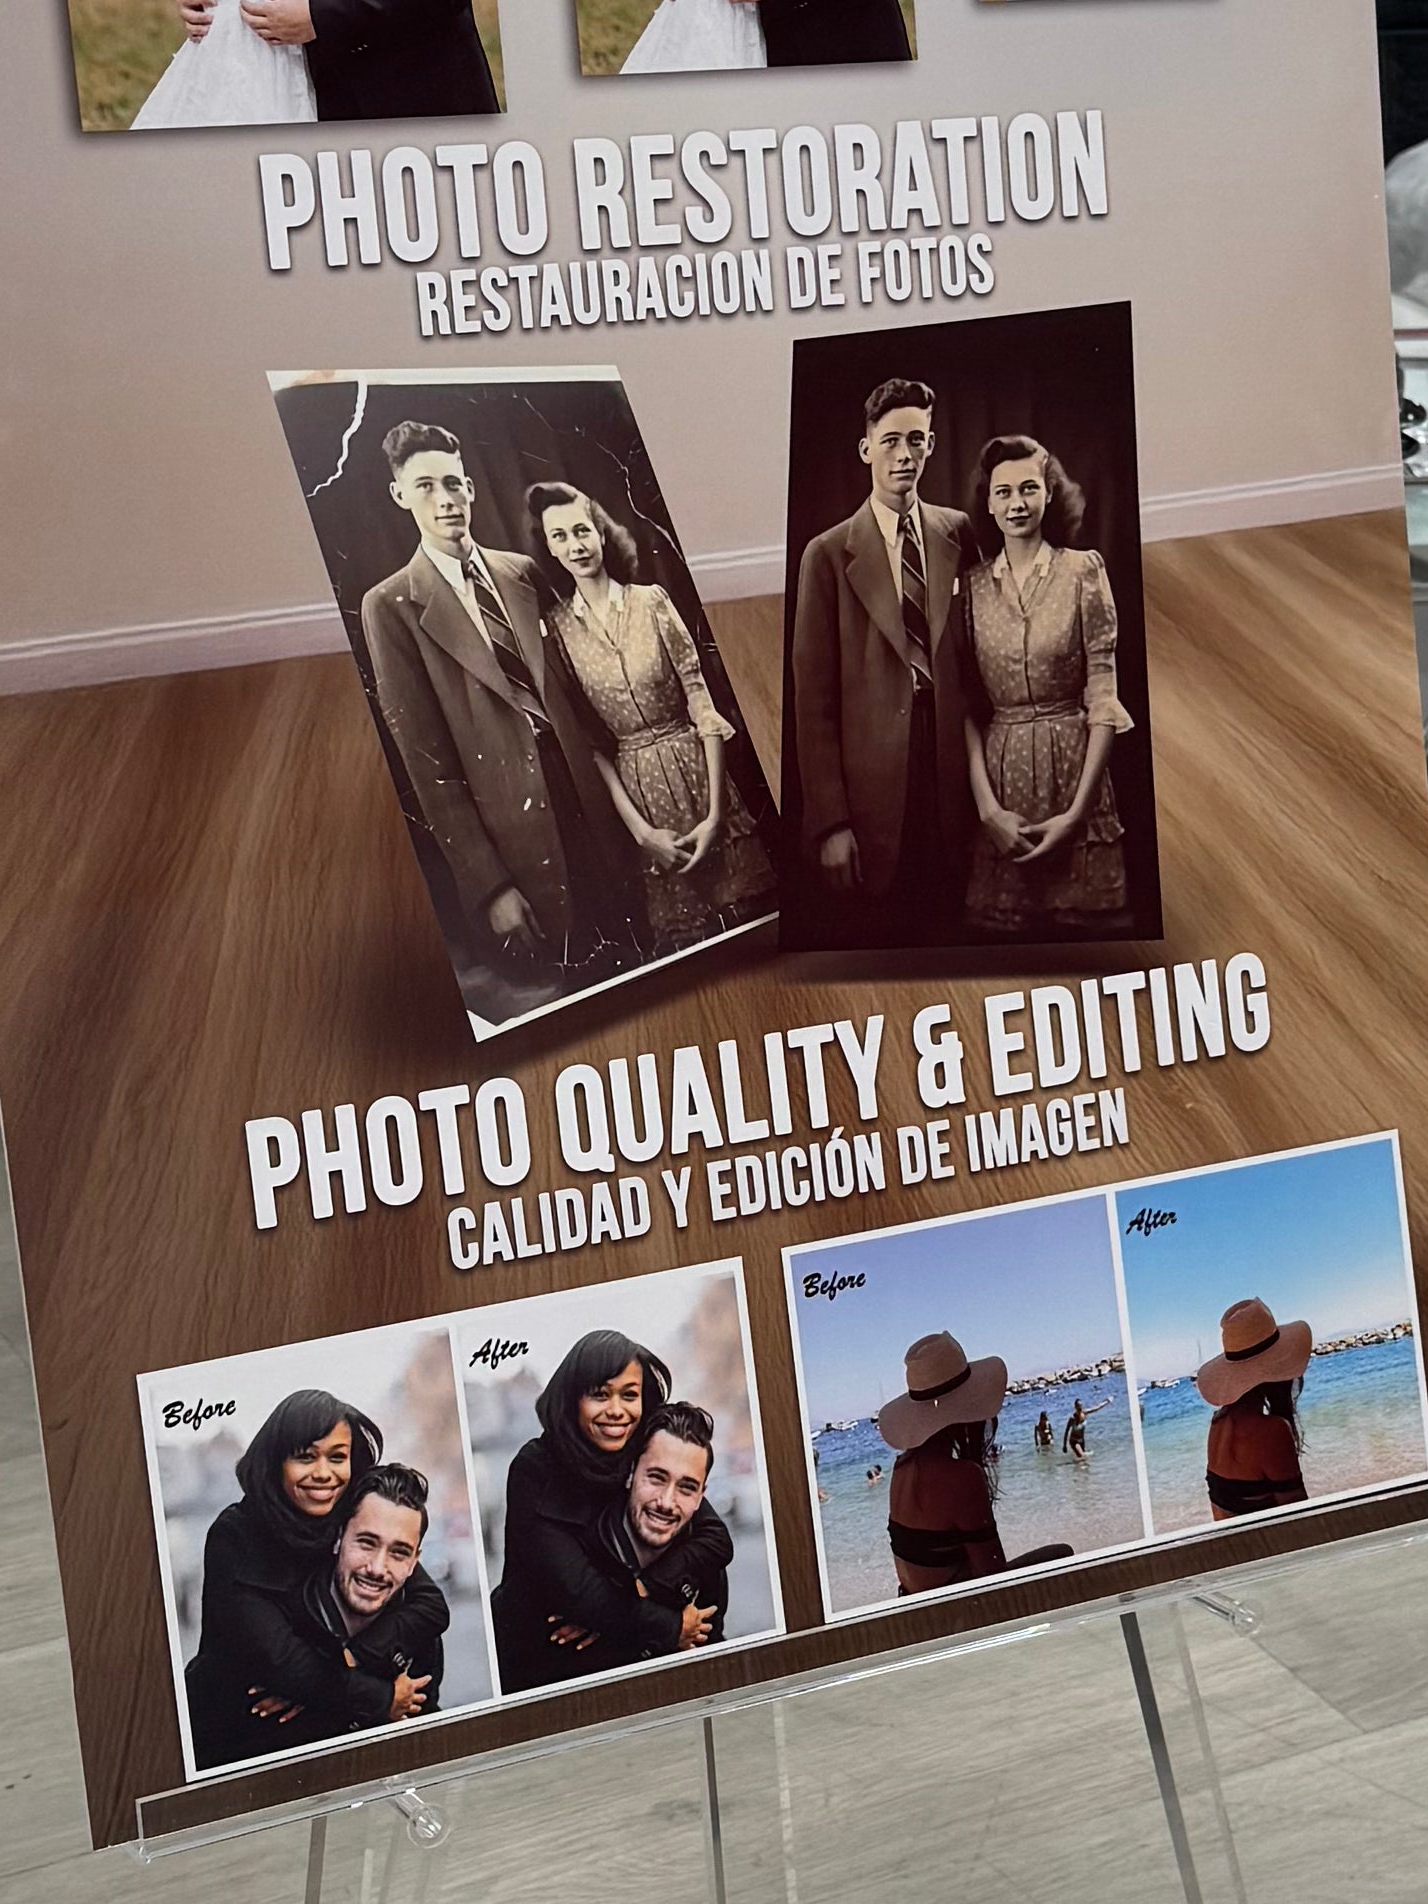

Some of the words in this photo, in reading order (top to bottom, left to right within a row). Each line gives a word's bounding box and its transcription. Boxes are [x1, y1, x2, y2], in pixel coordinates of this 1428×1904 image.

[258, 139, 549, 271] PHOTO
[573, 108, 1109, 251] RESTORATION
[416, 247, 775, 337] RESTAURACION
[785, 242, 846, 310] DE
[858, 232, 996, 304] FOTOS
[243, 1076, 532, 1231] PHOTO
[554, 1013, 886, 1174] QUALITY
[912, 1002, 967, 1109] &
[984, 951, 1272, 1097] EDITING
[446, 1175, 652, 1271] CALIDAD
[661, 1165, 693, 1229] Y
[705, 1125, 886, 1223] EDICIÓN
[896, 1118, 955, 1186] DE
[966, 1086, 1130, 1174] IMAGEN
[1126, 1207, 1178, 1237] After
[802, 1269, 867, 1300] Before
[469, 1338, 529, 1370] After
[162, 1397, 237, 1431] Before
